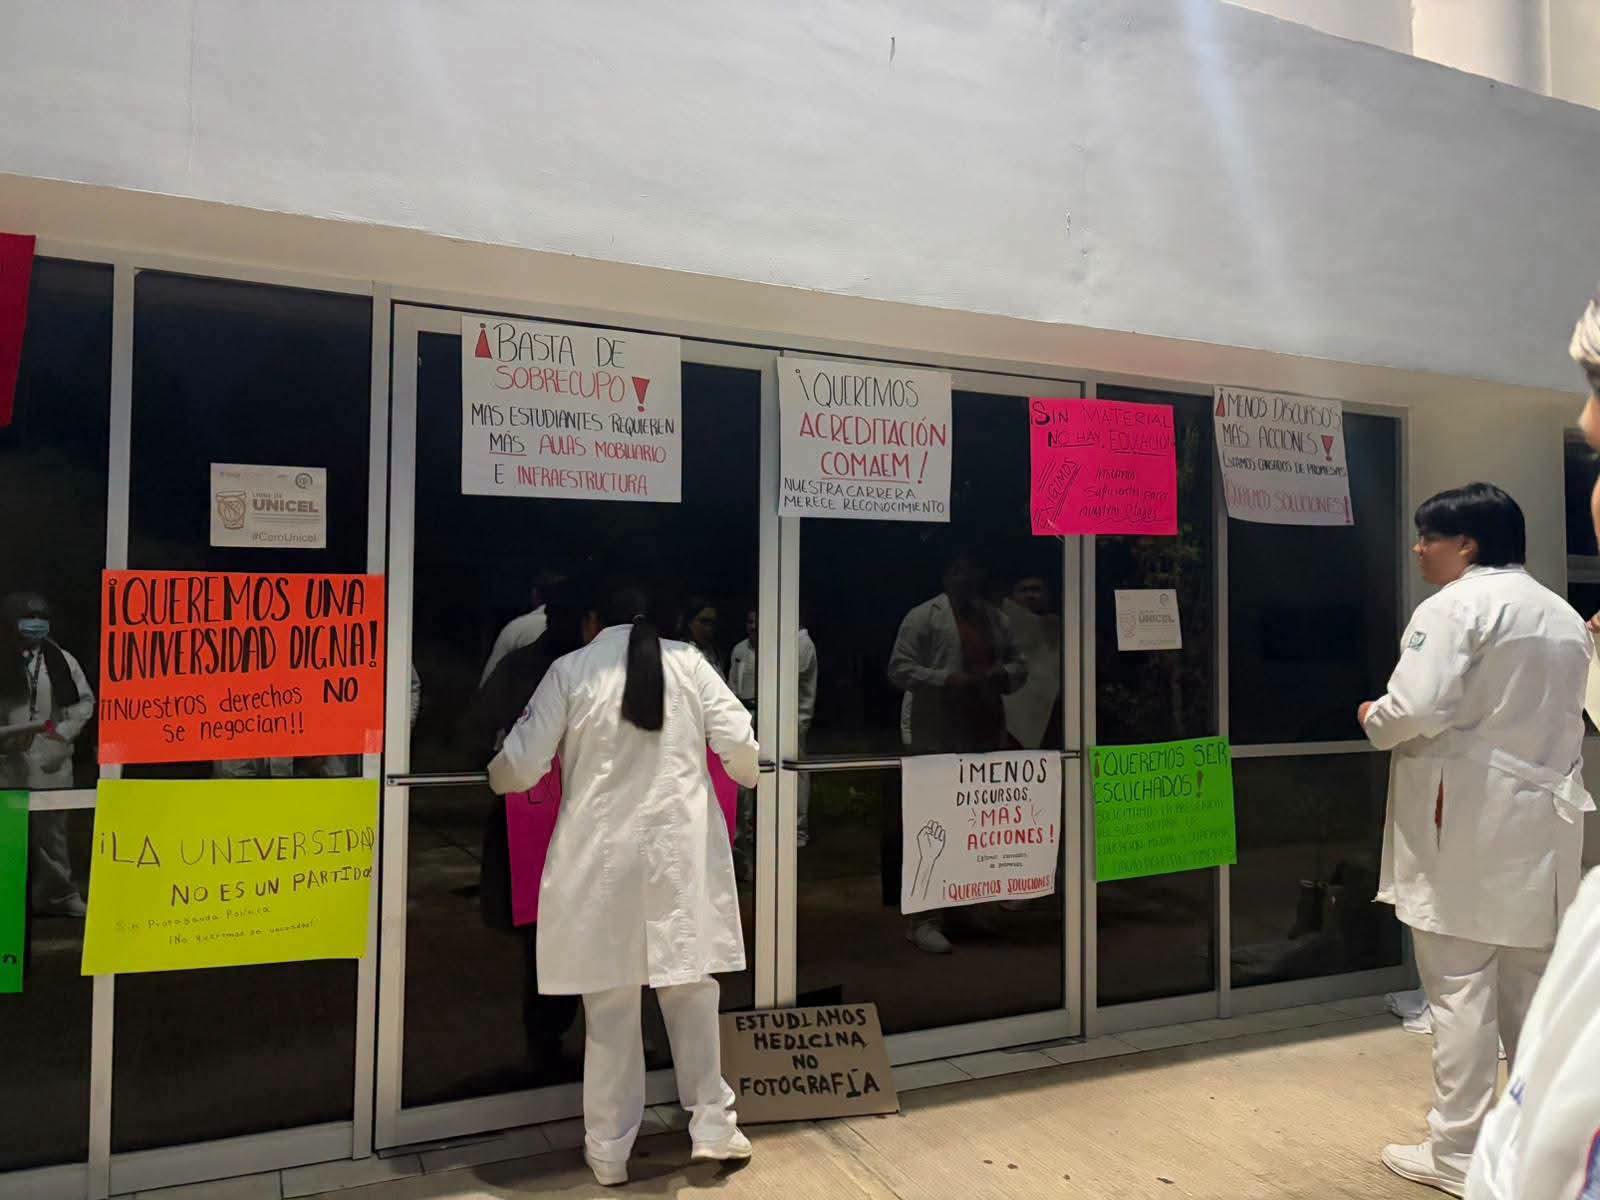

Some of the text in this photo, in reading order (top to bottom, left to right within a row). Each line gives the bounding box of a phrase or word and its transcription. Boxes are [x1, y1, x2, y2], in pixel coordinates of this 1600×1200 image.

[475, 323, 625, 368] ¡BASTA DE
[795, 368, 919, 408] ¡QUEREMOS
[510, 405, 603, 431] ESTUDIANTES
[610, 413, 675, 436] REQUIEREN
[1031, 400, 1069, 426] SIN
[1271, 398, 1341, 428] DISCURSOS
[800, 412, 946, 447] ACREDITACIÓN
[540, 434, 586, 456] AULAS
[595, 442, 666, 463] MOBILIARIO
[495, 463, 648, 496] E INFRAESTRUCTURA
[784, 477, 916, 500] NUESTRA CARRERA
[253, 499, 319, 513] UNICEL
[783, 495, 945, 514] MERECE RECONOCIMIENTO
[109, 576, 364, 626] ¡QUEREMOS UNA
[108, 621, 378, 682] UNIVERSIDAD DIGNA!
[219, 684, 303, 713] derechos
[323, 677, 359, 703] NO
[200, 712, 304, 740] negocian!!
[1193, 741, 1228, 768] SER
[959, 758, 1047, 784] ¡MENOS
[100, 826, 375, 868] ¡LA UNIVERSIDAD
[171, 884, 209, 907] NO
[220, 881, 245, 901] ES
[255, 878, 279, 896] UN
[942, 879, 1002, 901] ¡QUEREMOS
[735, 1008, 867, 1032] ESTUDIAMOS
[754, 1031, 867, 1050] MEDICINA
[792, 1054, 819, 1070] NO
[739, 1069, 880, 1099] FOTOGRAFÍA
